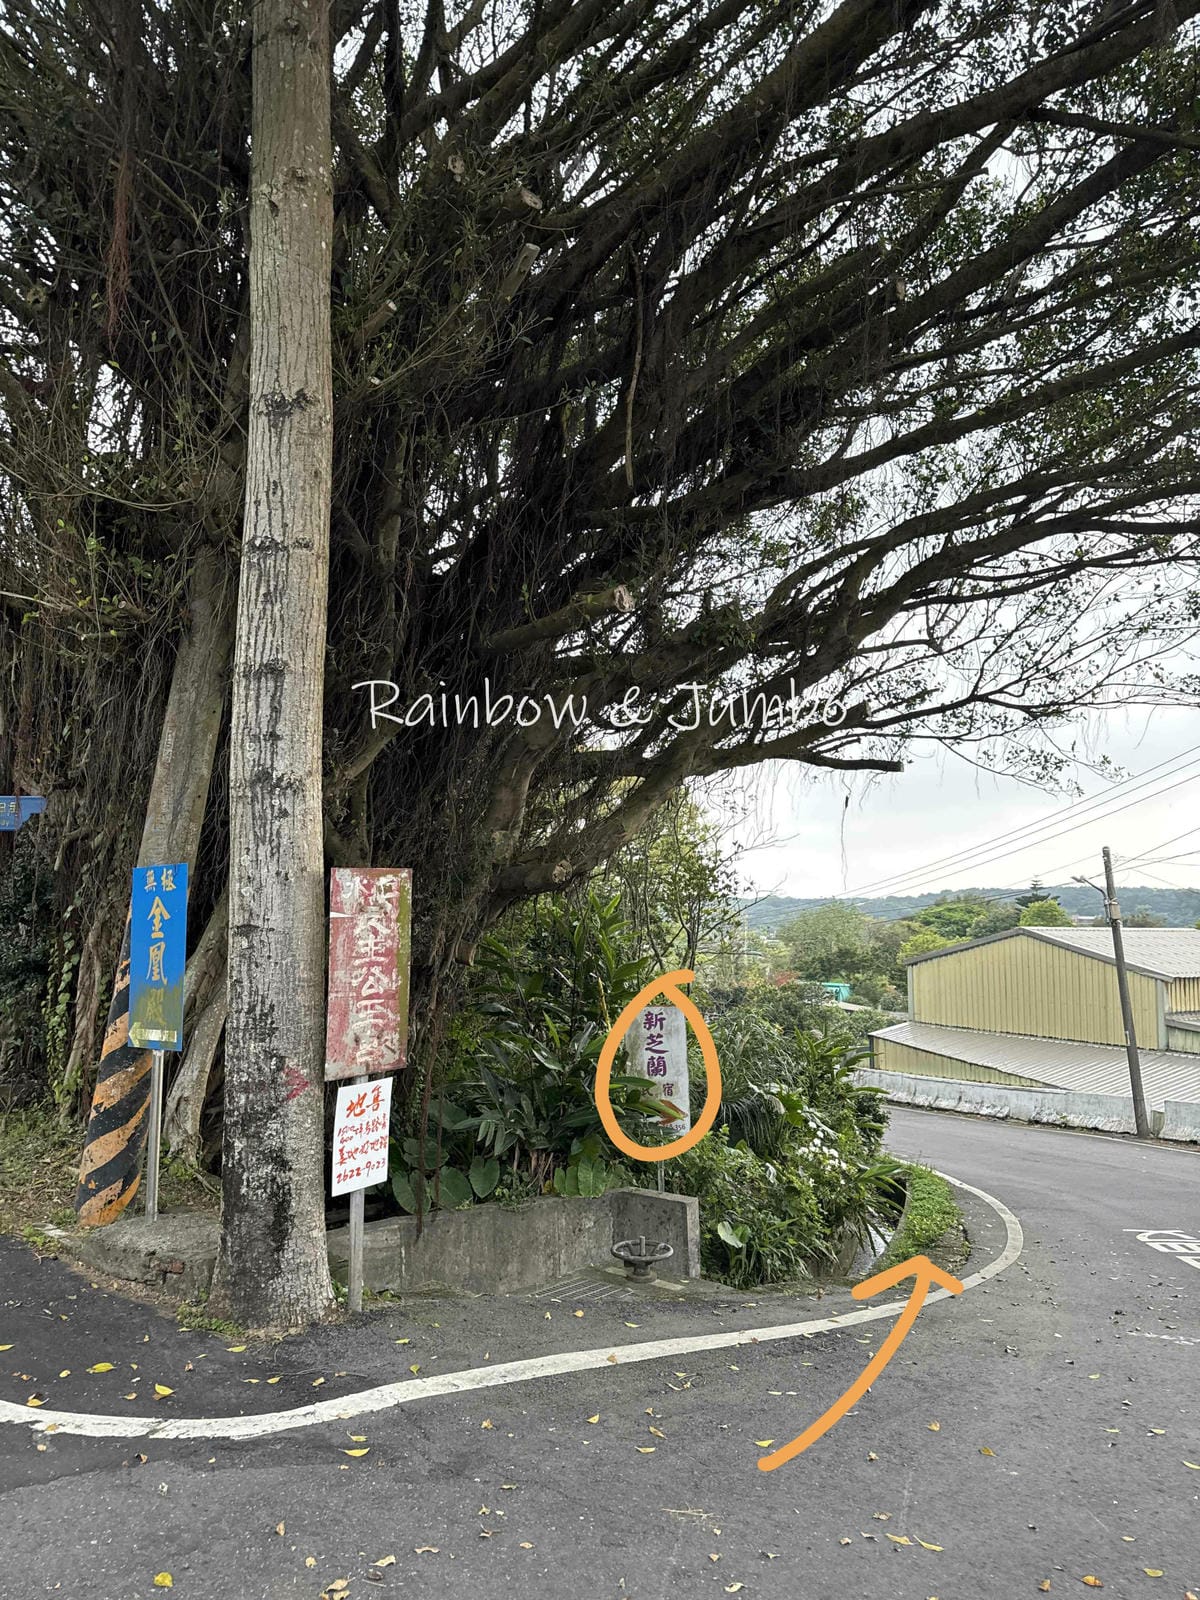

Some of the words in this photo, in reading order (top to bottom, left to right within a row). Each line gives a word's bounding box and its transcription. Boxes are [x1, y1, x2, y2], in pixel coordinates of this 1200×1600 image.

[643, 1011, 669, 1077] 新芝蘭
[345, 1084, 385, 1118] 地售
